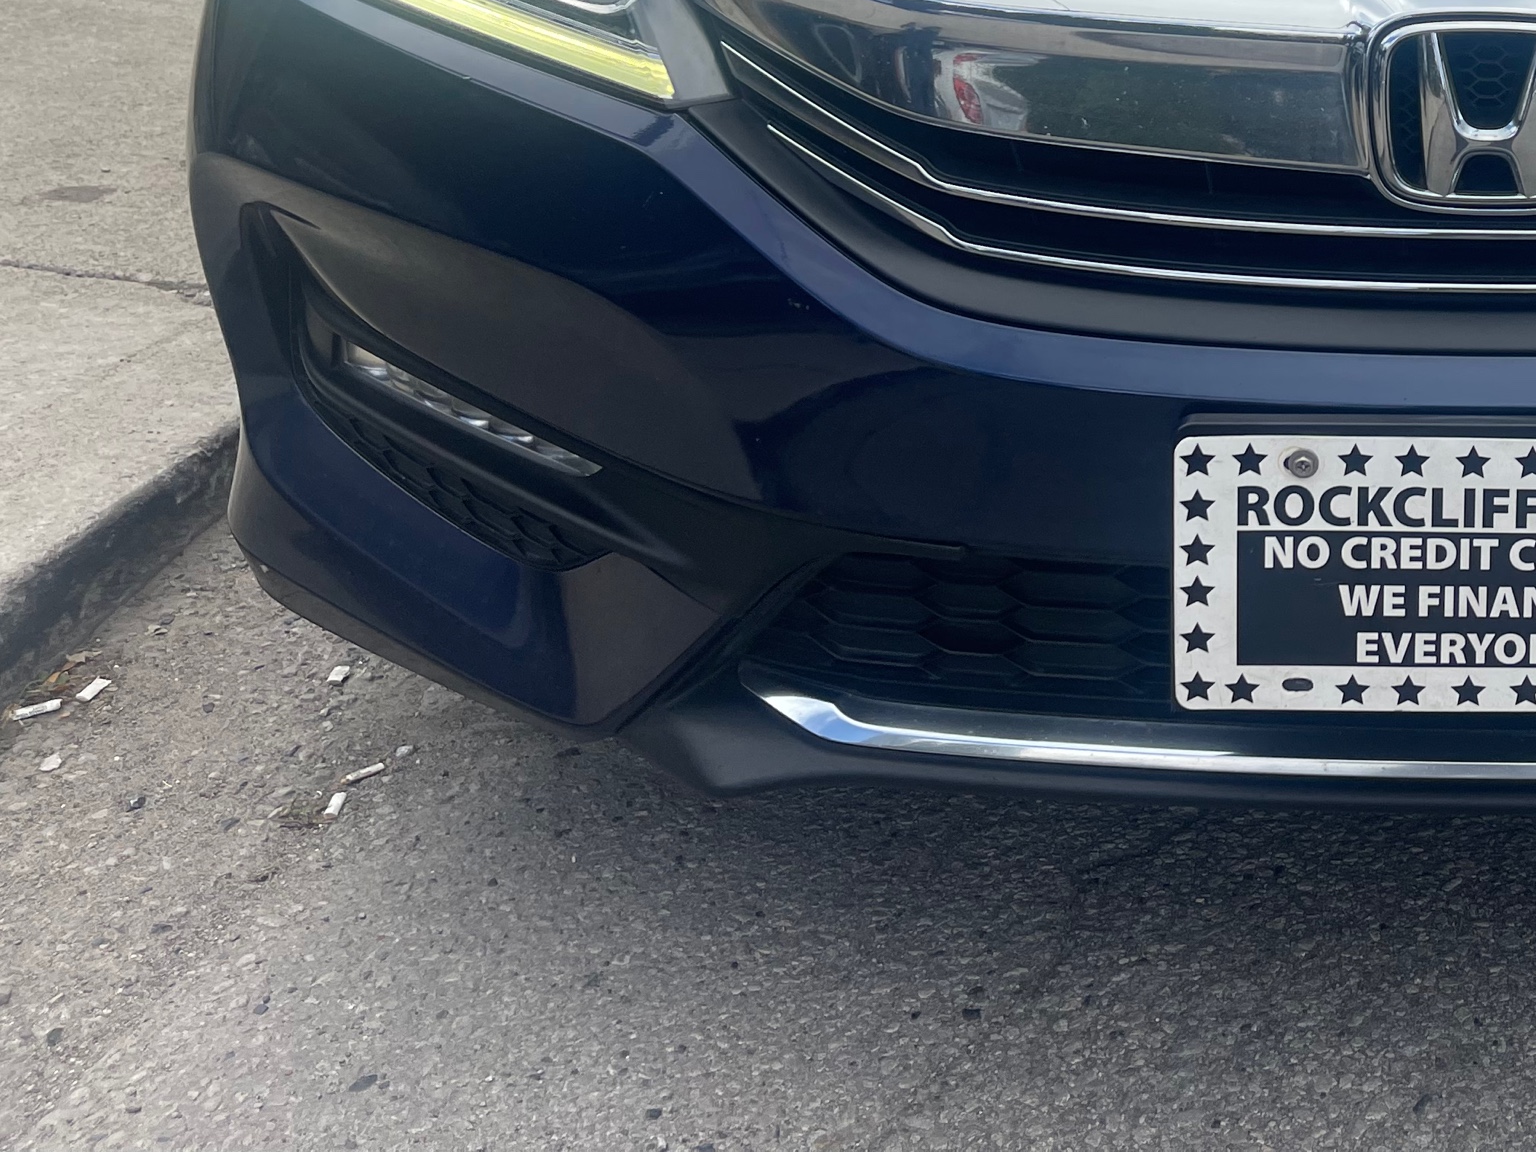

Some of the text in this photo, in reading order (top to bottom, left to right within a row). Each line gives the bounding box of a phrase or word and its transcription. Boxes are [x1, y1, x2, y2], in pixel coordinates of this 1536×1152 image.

[1264, 535, 1330, 569] NO
[1341, 536, 1500, 571] CREDIT
[1338, 584, 1406, 617] WE
